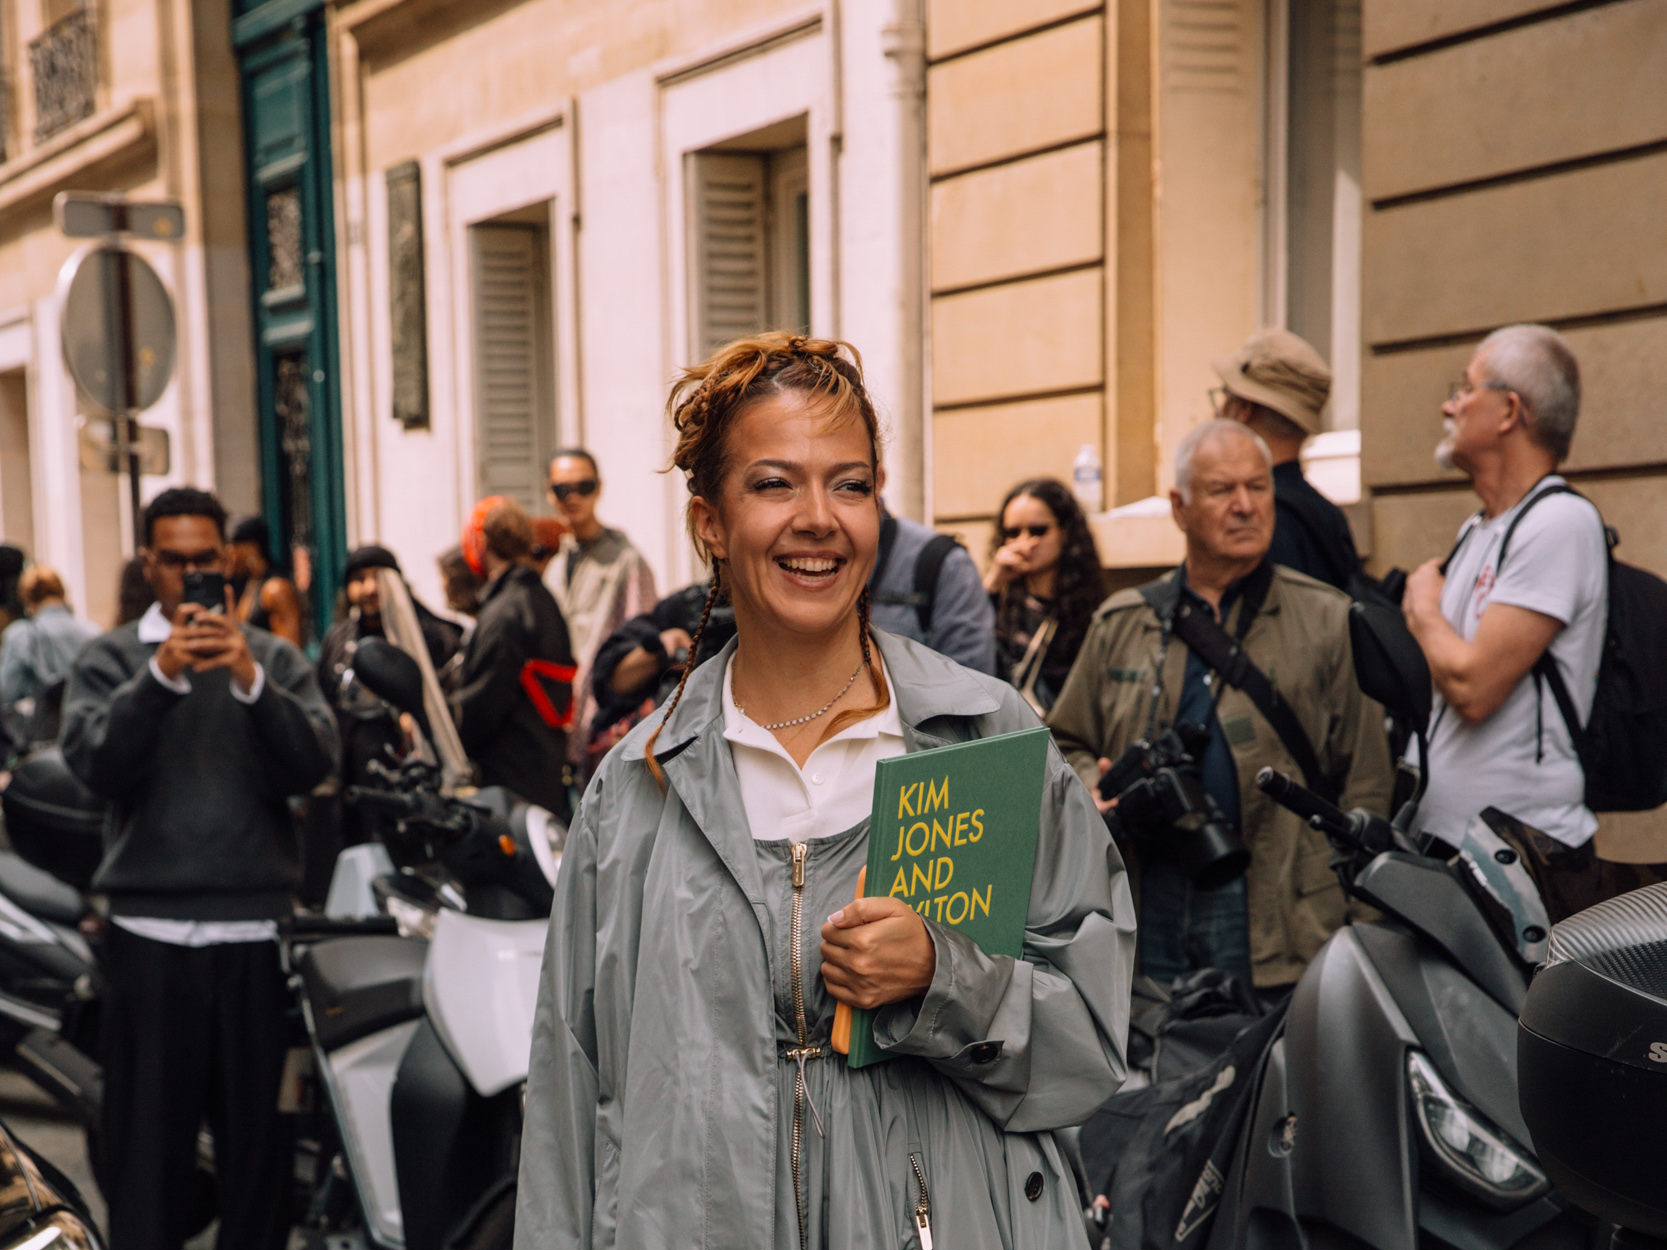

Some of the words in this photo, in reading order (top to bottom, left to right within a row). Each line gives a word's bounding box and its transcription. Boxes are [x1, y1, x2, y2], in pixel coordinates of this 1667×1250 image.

[898, 774, 949, 819] KIM
[890, 808, 985, 861] JONES
[888, 856, 954, 898] AND
